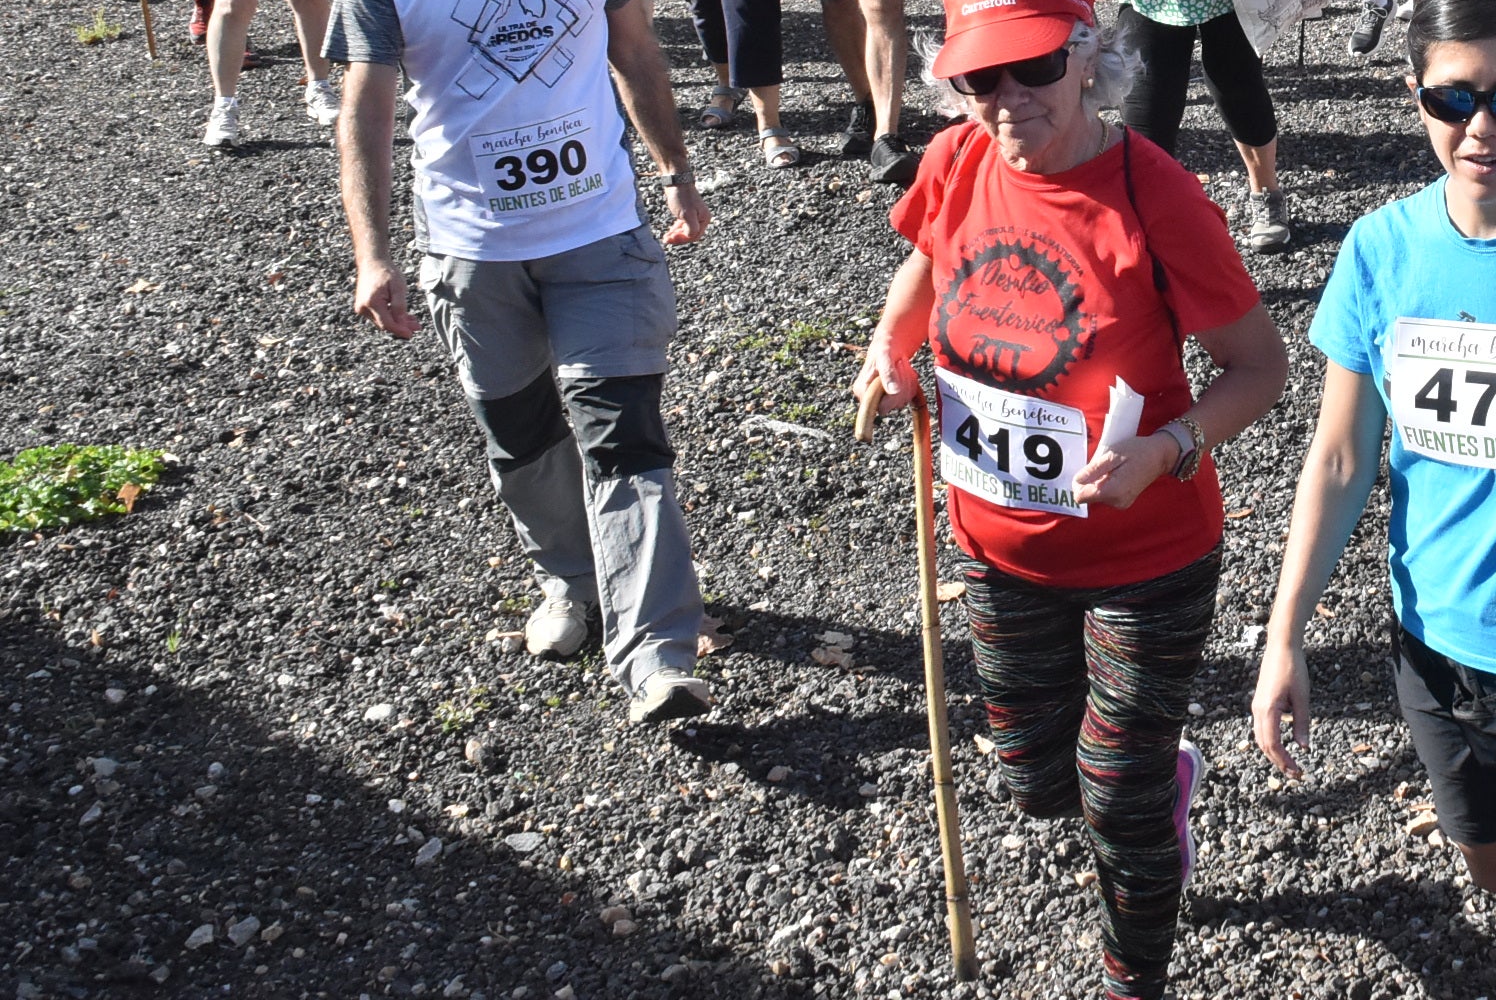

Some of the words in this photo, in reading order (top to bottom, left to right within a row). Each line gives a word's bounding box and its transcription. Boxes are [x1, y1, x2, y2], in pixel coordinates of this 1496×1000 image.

[497, 22, 526, 33] ULTRA
[526, 20, 538, 29] DE
[482, 131, 533, 152] marcha
[494, 139, 587, 191] 390
[489, 190, 547, 213] FUENTES
[549, 185, 566, 203] DE
[568, 173, 604, 198] BÉJAR
[1411, 332, 1479, 359] marcha
[955, 414, 1064, 481] 419
[1403, 425, 1479, 457] FUENTES
[944, 453, 998, 495] FUENTES
[1002, 479, 1024, 501] DE
